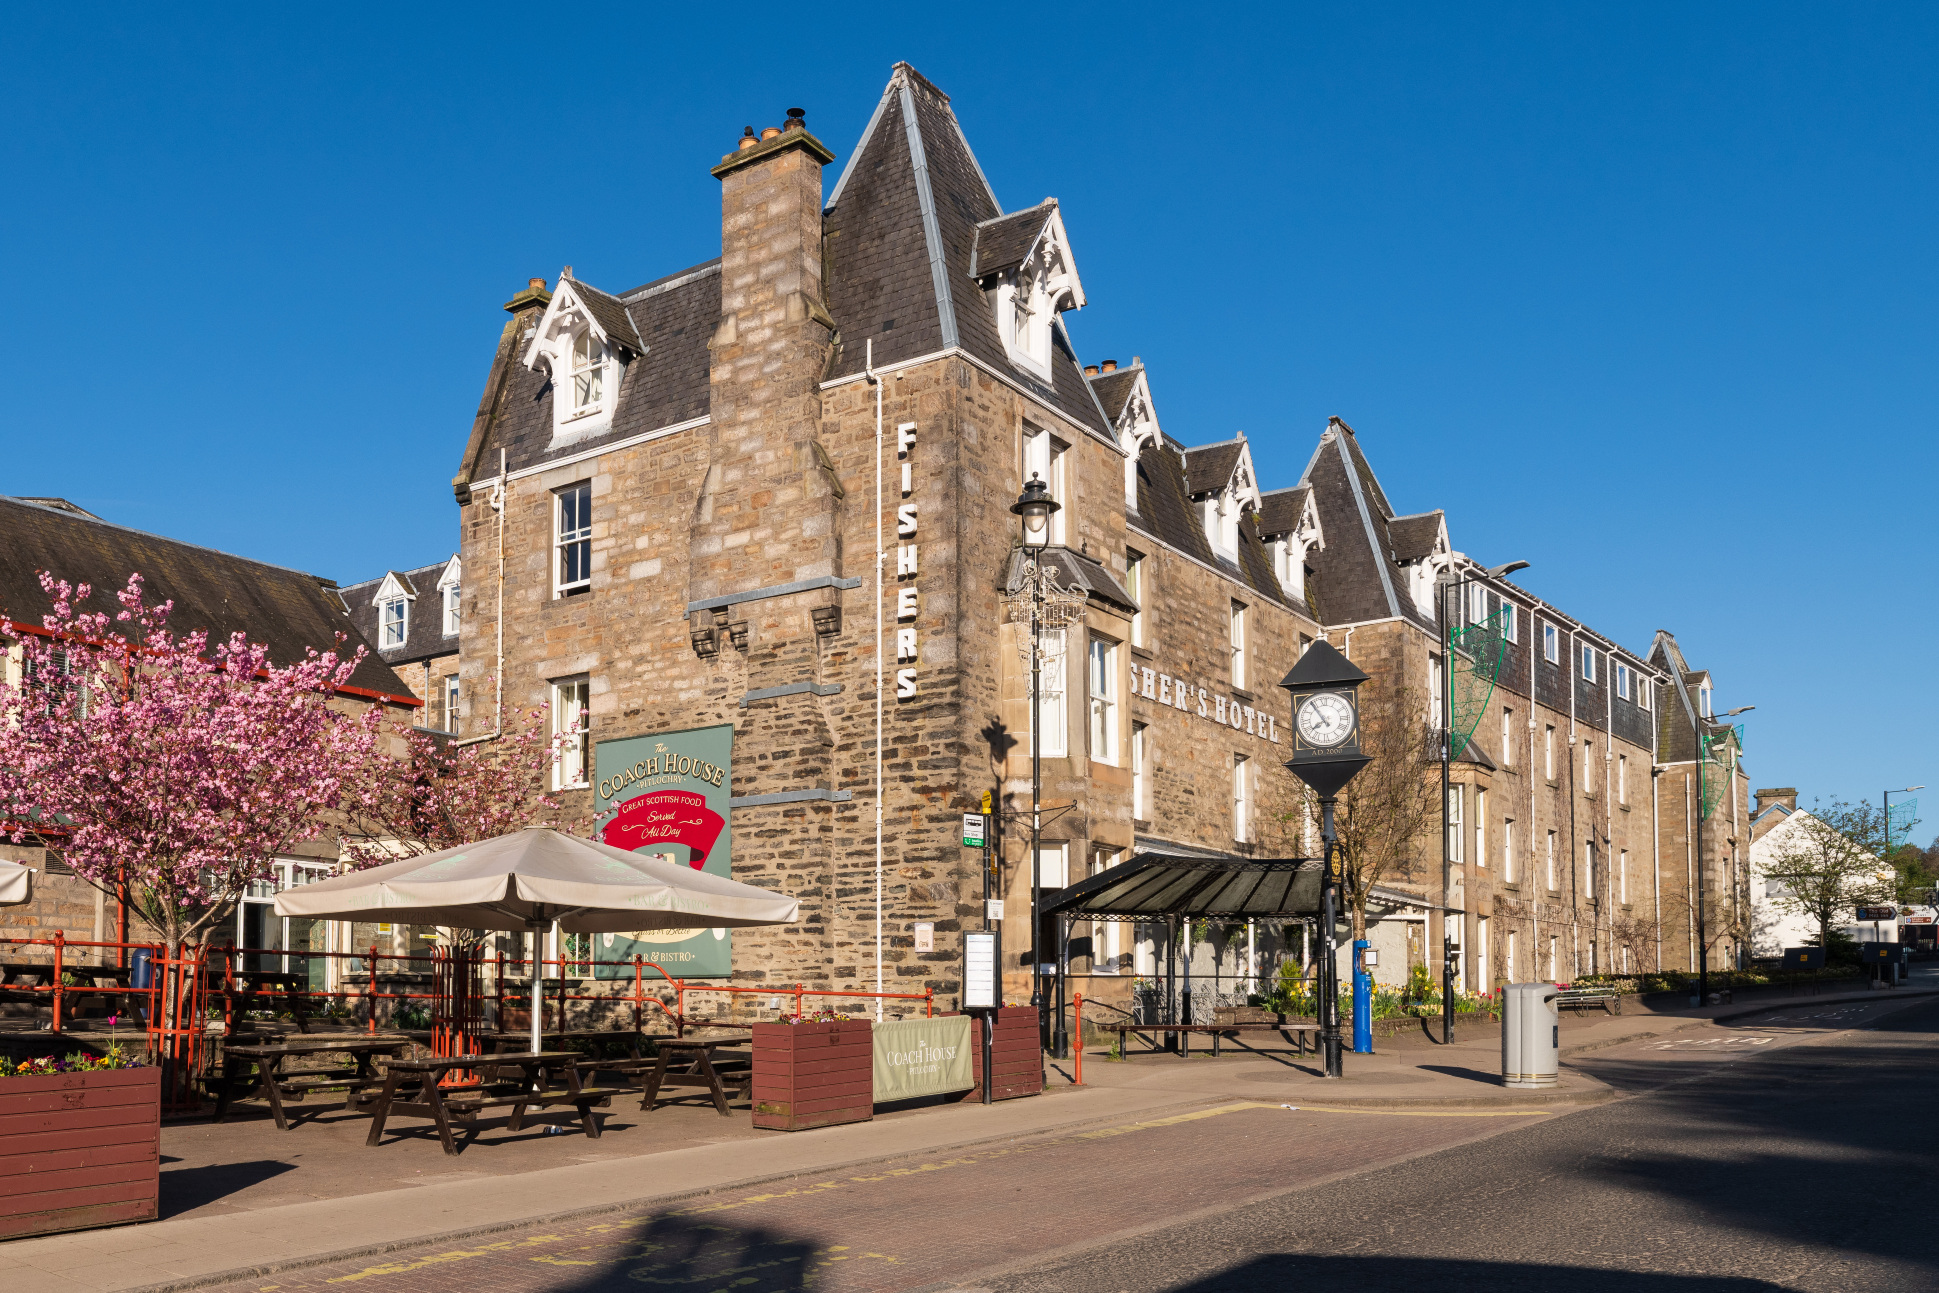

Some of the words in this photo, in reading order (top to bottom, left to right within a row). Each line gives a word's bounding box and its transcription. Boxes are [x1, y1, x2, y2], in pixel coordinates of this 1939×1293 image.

[897, 421, 918, 699] FISHERS
[1214, 694, 1279, 743] HOTEL
[655, 743, 668, 753] The
[599, 757, 660, 800] COACH
[663, 753, 726, 788] HOUSE
[639, 775, 683, 789] PITLOCHRY
[622, 799, 645, 814] GREAT
[646, 796, 679, 805] SCOTTISH
[681, 796, 702, 807] FOOD
[646, 810, 677, 823] Served
[640, 825, 659, 839] All
[660, 824, 682, 837] Day
[634, 894, 655, 906] BAR
[632, 953, 649, 962] BR
[650, 951, 660, 962] &
[660, 951, 692, 962] BISTRO
[887, 1050, 922, 1066] COACH
[925, 1046, 956, 1061] HOUSE
